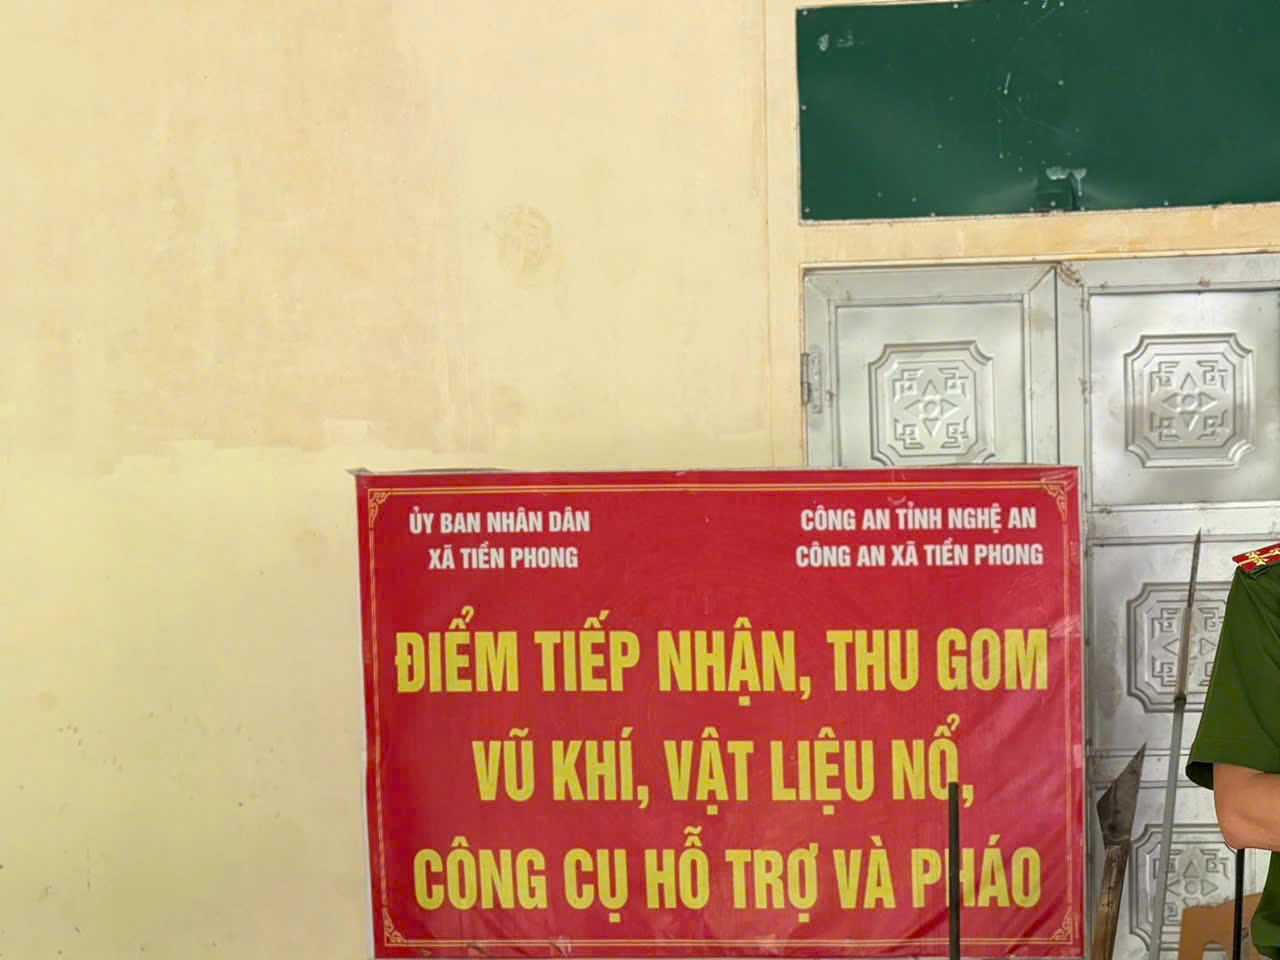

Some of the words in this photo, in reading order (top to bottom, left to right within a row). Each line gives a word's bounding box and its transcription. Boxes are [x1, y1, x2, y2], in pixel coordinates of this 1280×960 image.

[409, 505, 435, 535] ỦY
[440, 511, 481, 534] BAN
[486, 506, 544, 533] NHÂN
[548, 506, 591, 533] DÂN
[800, 504, 857, 532] CÔNG
[861, 508, 891, 531] AN
[895, 501, 942, 530] TỈNH
[947, 502, 1003, 534] NGHỆ
[1007, 506, 1037, 529] AN
[428, 544, 456, 570] XÃ
[510, 546, 579, 569] PHONG
[795, 540, 852, 568] CÔNG
[856, 544, 886, 568] AN
[890, 540, 919, 567] XÃ
[974, 543, 1044, 566] PHONG
[394, 605, 520, 693] ĐIỂM
[533, 609, 641, 692] TIẾP
[657, 616, 812, 707] NHẬN,
[825, 628, 920, 692] THU
[936, 627, 1049, 692] GOM
[471, 727, 535, 802] VŨ
[551, 726, 650, 809] KHÍ,
[663, 726, 755, 816] VẬT
[769, 726, 875, 816] LIỆU
[891, 712, 975, 809] NỔ,
[413, 835, 549, 911] CÔNG
[563, 847, 629, 924] CỤ
[644, 825, 711, 910] HỖ
[724, 842, 819, 924] TRỢ
[832, 835, 897, 910] VÀ
